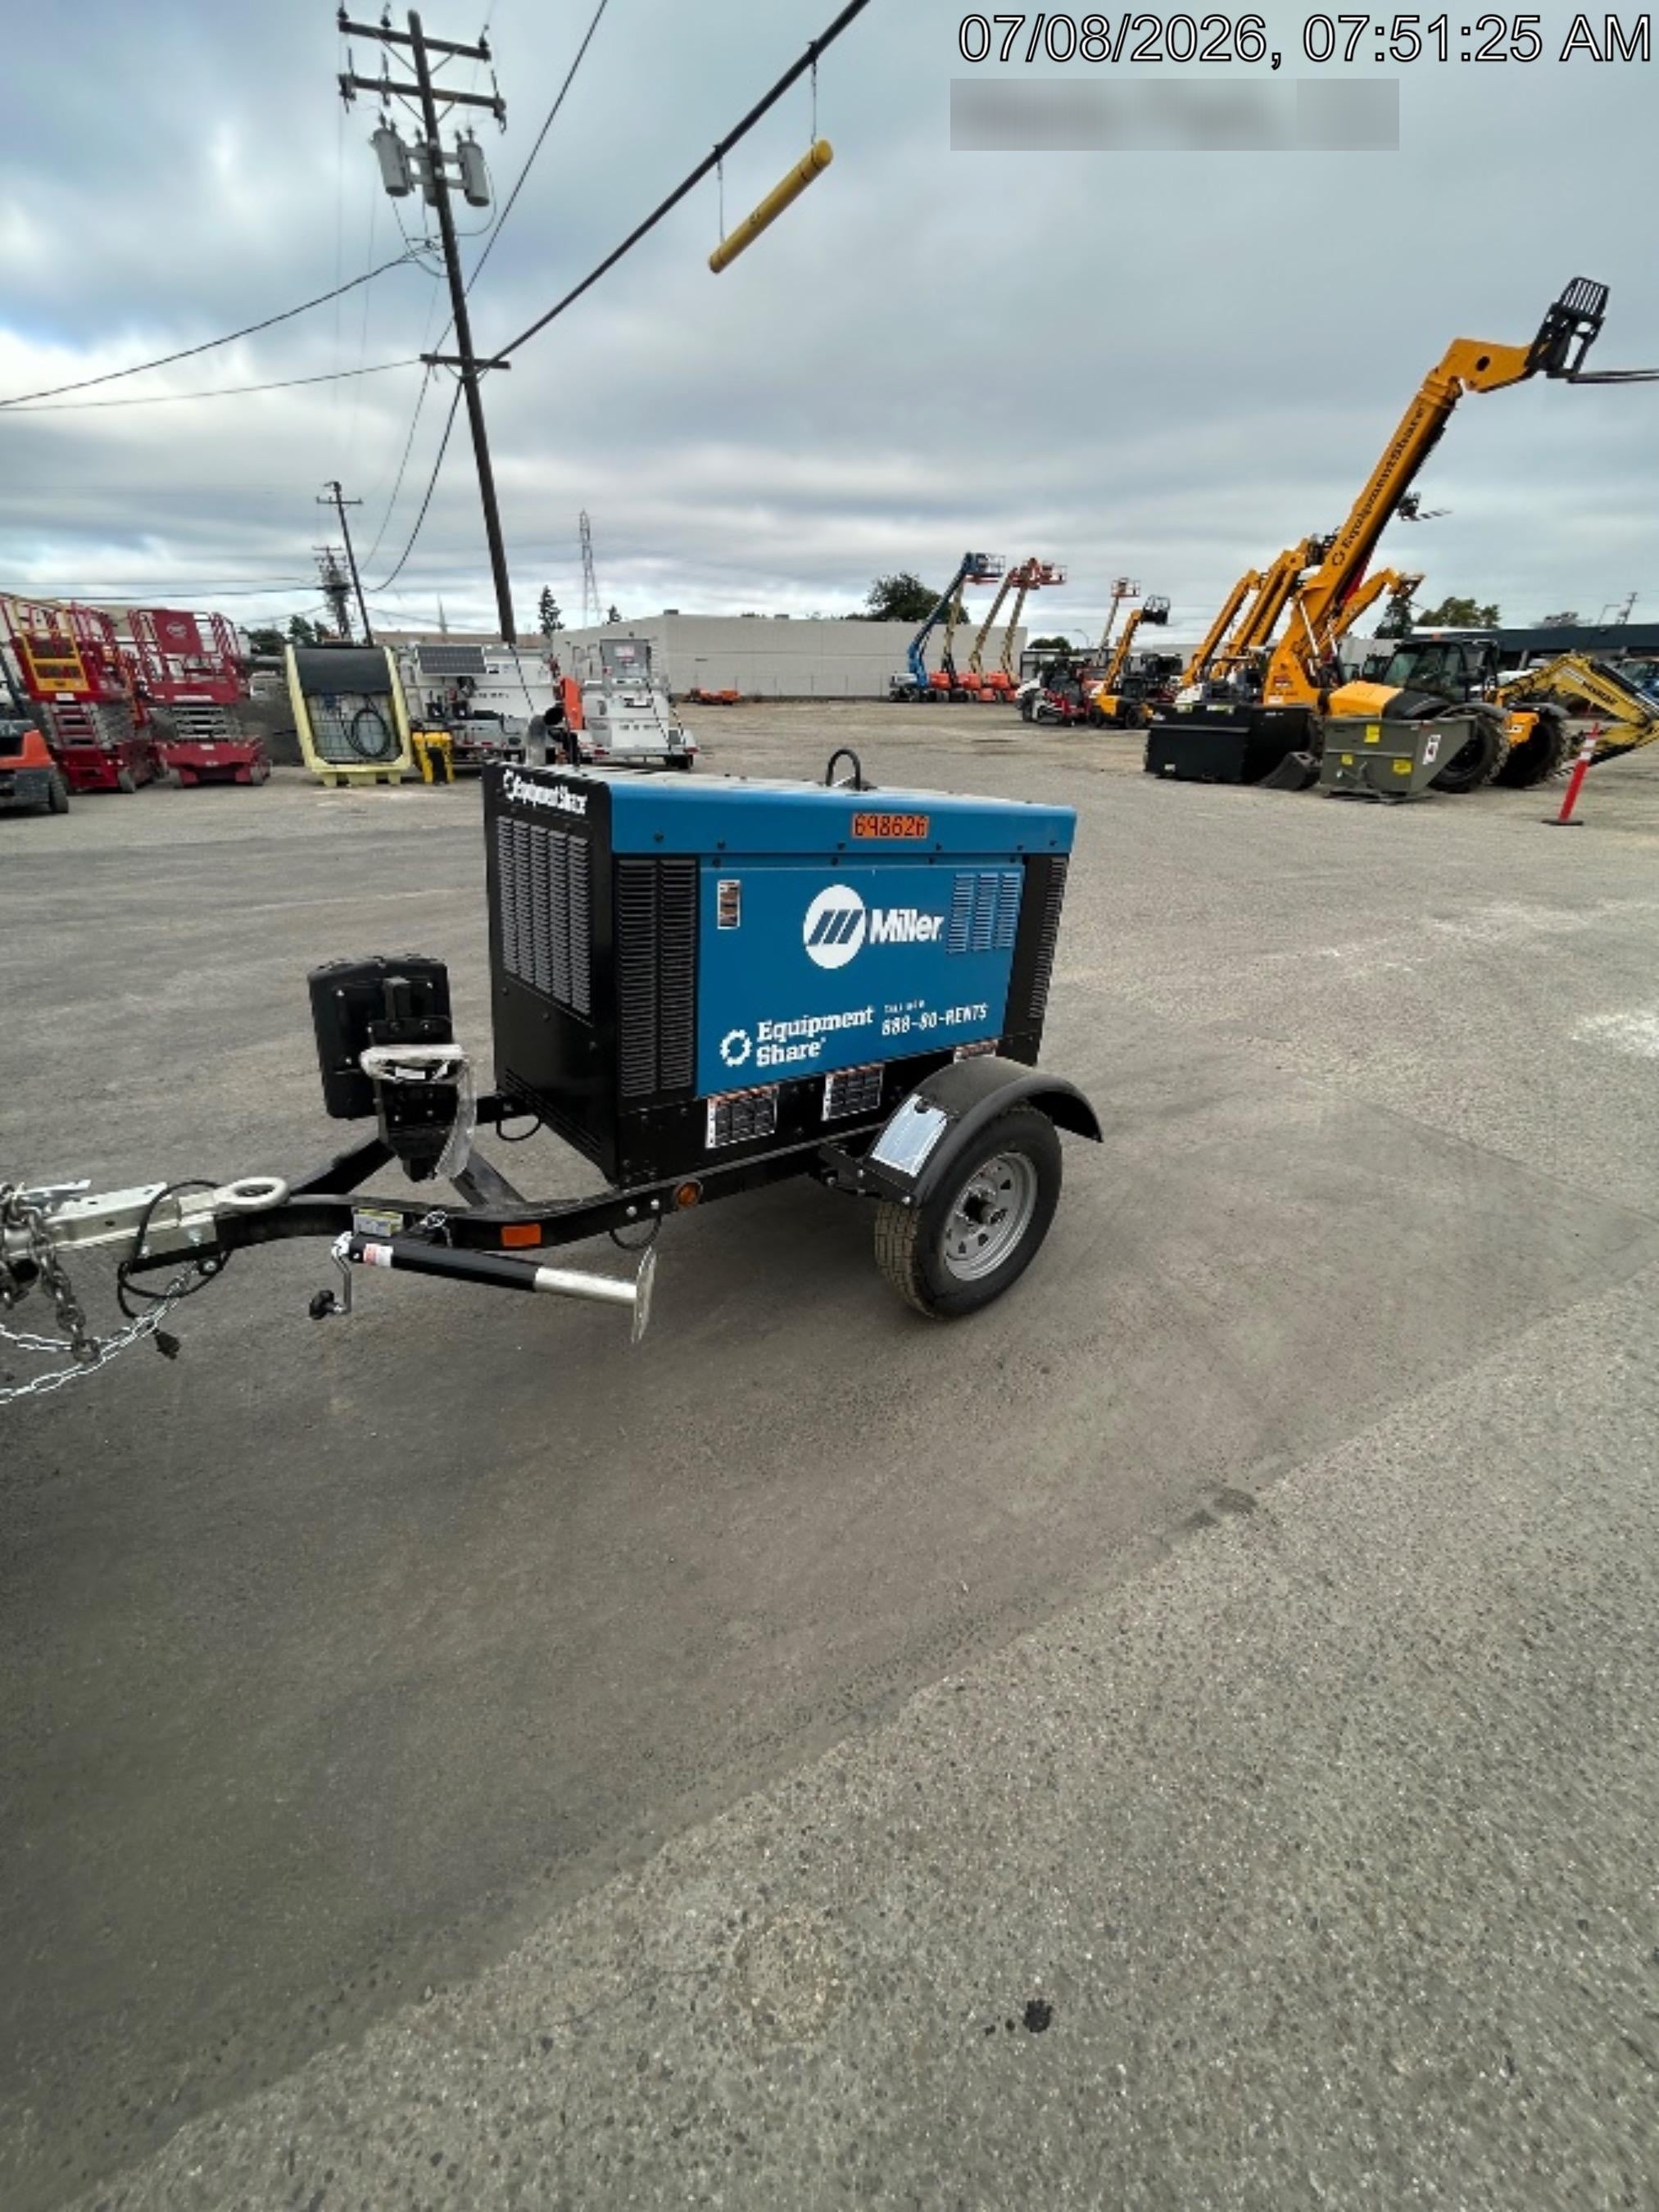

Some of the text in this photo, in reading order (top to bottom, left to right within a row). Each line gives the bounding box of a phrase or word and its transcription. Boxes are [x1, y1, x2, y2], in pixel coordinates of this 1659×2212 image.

[854, 814, 926, 836] 698626
[870, 908, 944, 944] Miller
[757, 1005, 874, 1043] Equipment
[757, 1040, 821, 1067] Share
